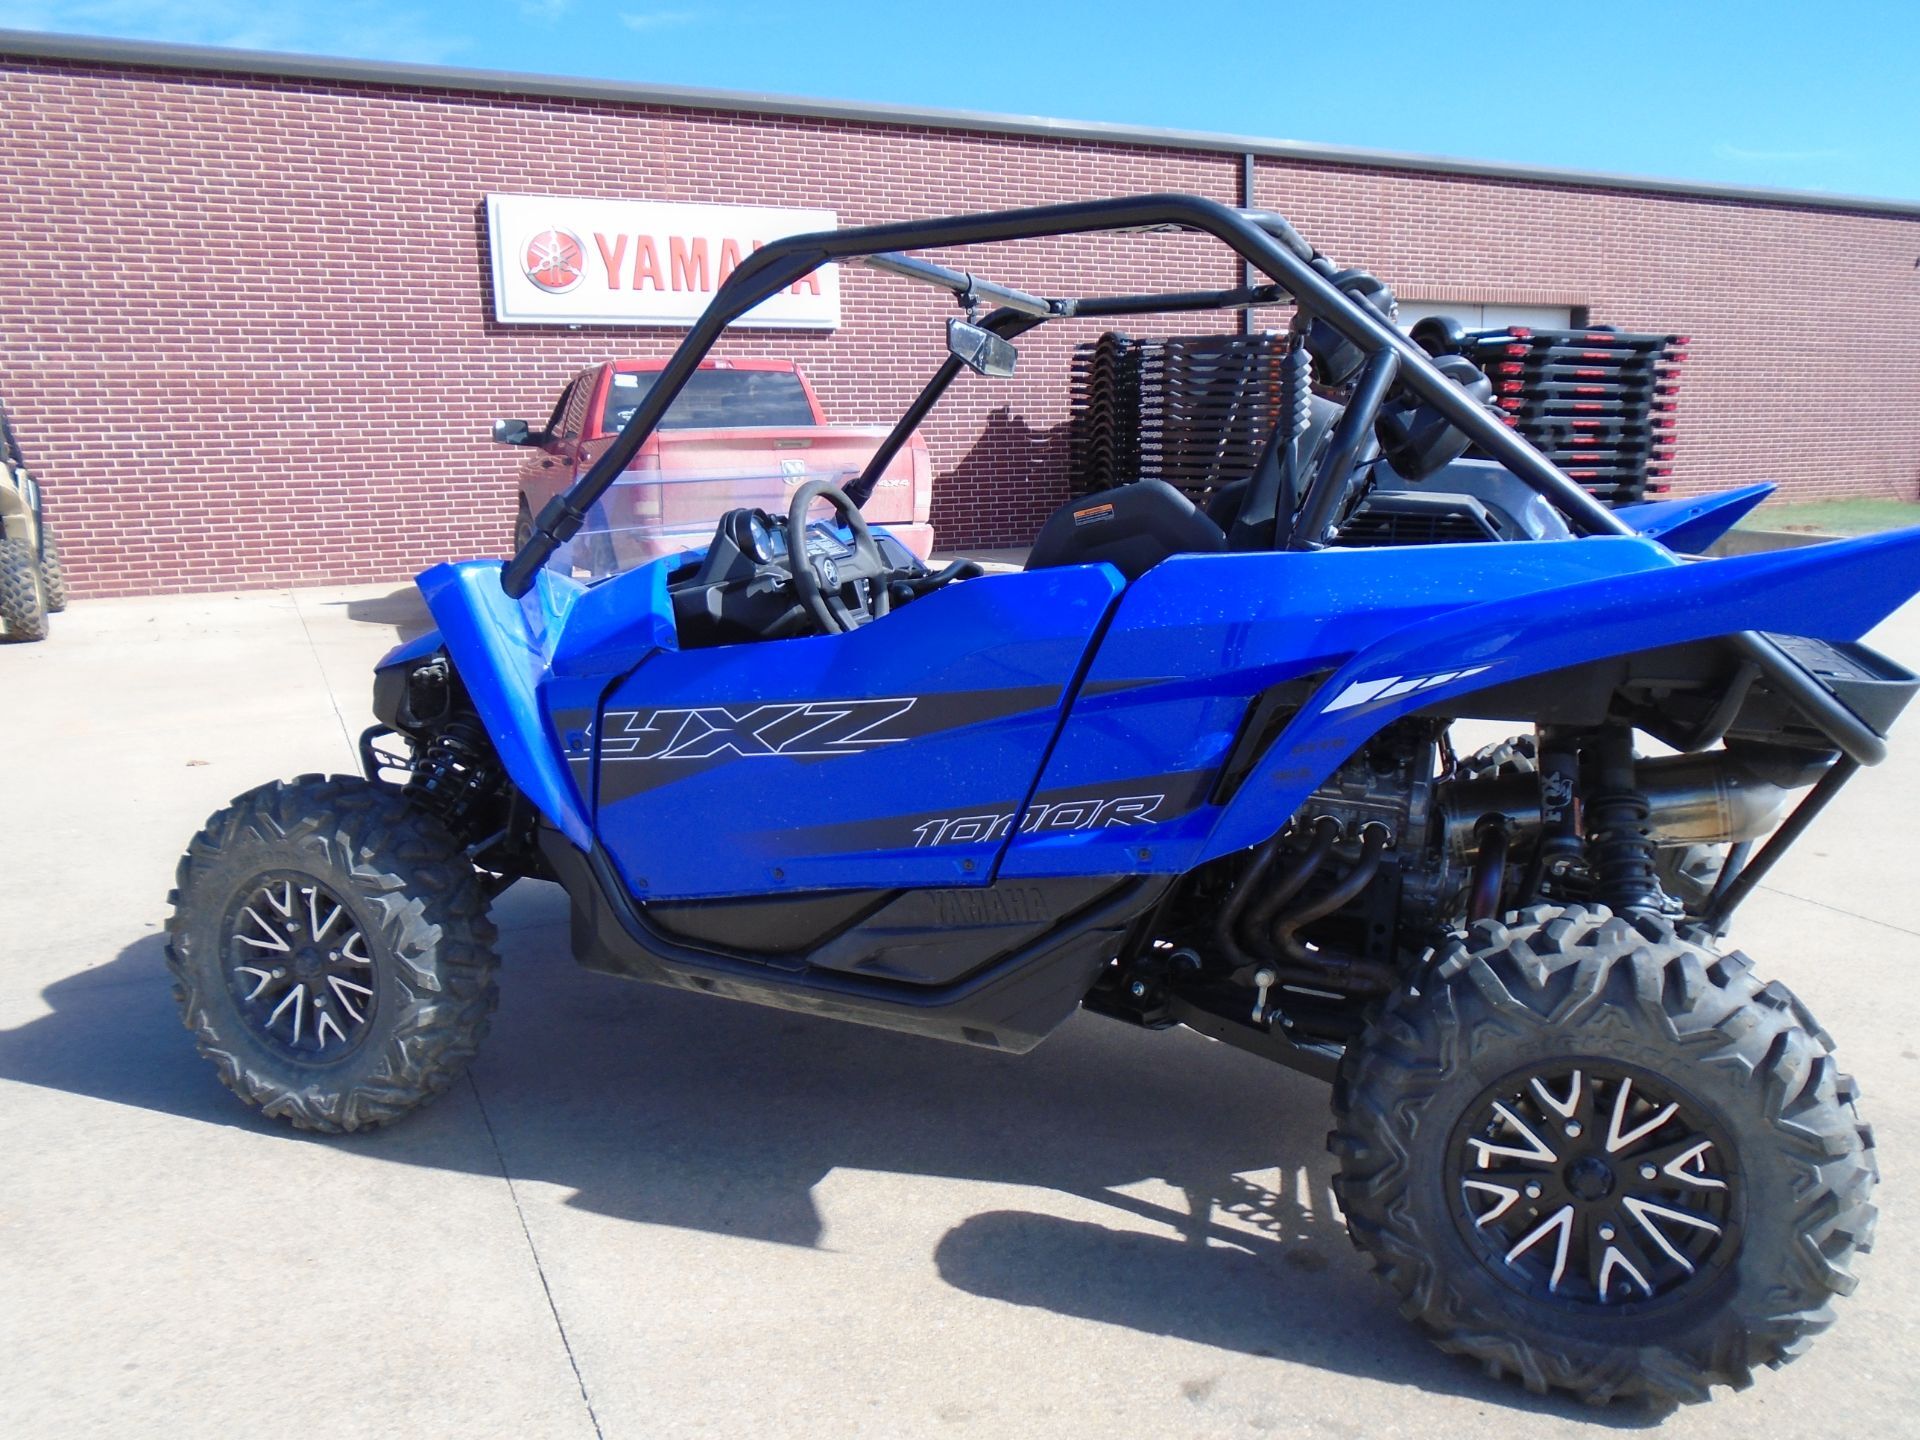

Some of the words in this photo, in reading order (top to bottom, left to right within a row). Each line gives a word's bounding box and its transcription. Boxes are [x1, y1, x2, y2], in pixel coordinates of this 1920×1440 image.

[593, 231, 821, 296] YAMA
[565, 697, 918, 762] YXZ
[913, 794, 1165, 848] 1000R
[925, 887, 1048, 923] YAMAHA
